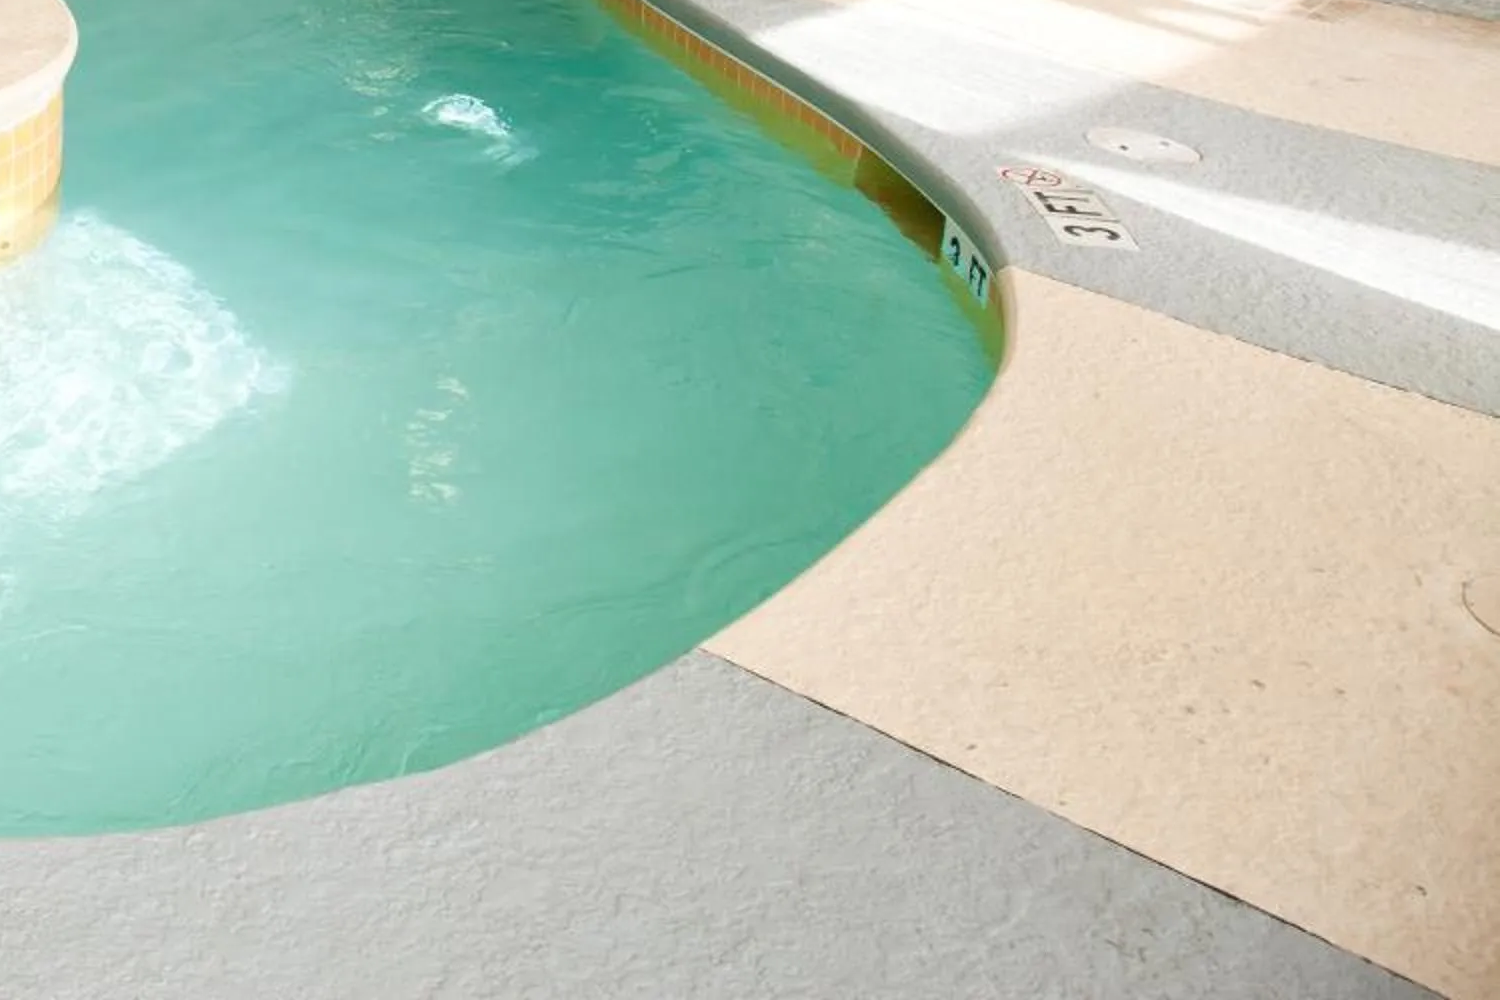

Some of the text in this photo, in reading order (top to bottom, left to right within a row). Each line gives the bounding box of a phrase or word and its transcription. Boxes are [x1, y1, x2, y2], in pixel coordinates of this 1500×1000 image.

[1034, 191, 1121, 241] 3 FT
[969, 254, 987, 297] FT
